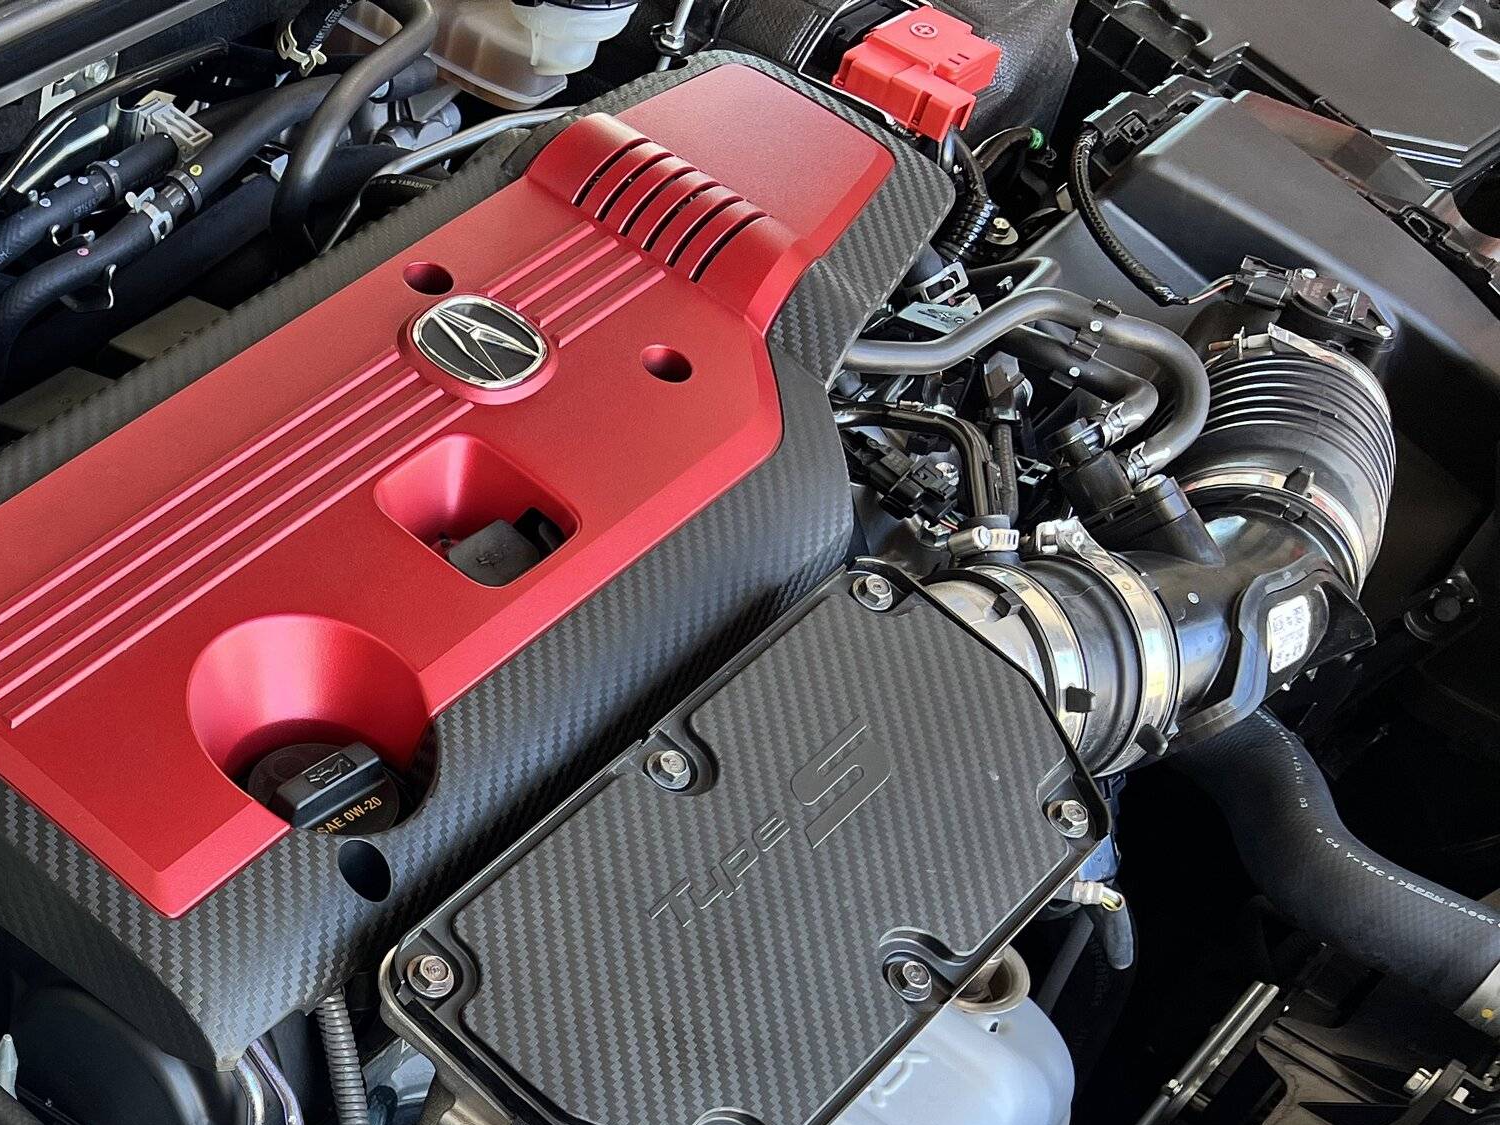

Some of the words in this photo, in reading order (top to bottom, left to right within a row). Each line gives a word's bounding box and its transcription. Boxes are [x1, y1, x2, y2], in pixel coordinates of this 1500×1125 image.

[791, 715, 891, 850] S
[317, 817, 346, 834] SAE
[344, 797, 381, 821] 0W-20
[1346, 851, 1385, 877] Y-TEC
